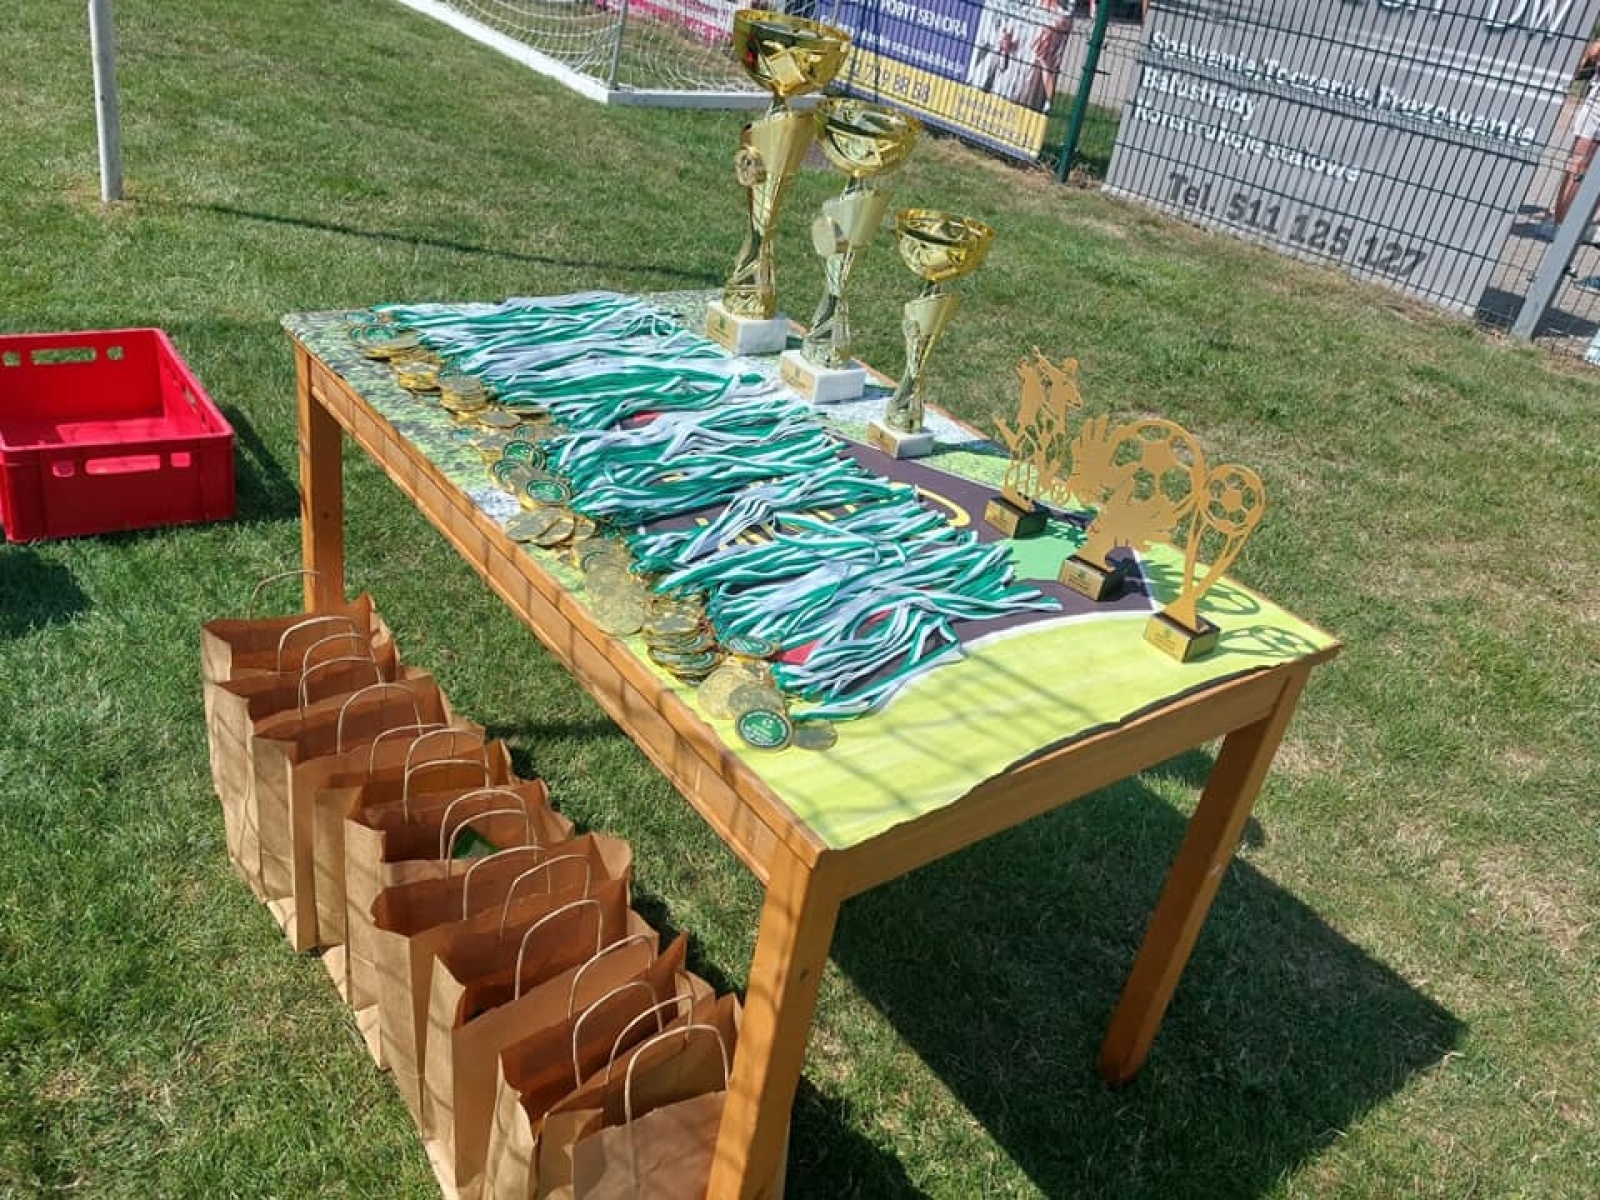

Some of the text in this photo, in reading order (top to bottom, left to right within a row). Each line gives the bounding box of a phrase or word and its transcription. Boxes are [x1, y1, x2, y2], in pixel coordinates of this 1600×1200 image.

[1226, 191, 1282, 234] 511
[1289, 214, 1353, 256] 125
[1357, 235, 1429, 277] 127
